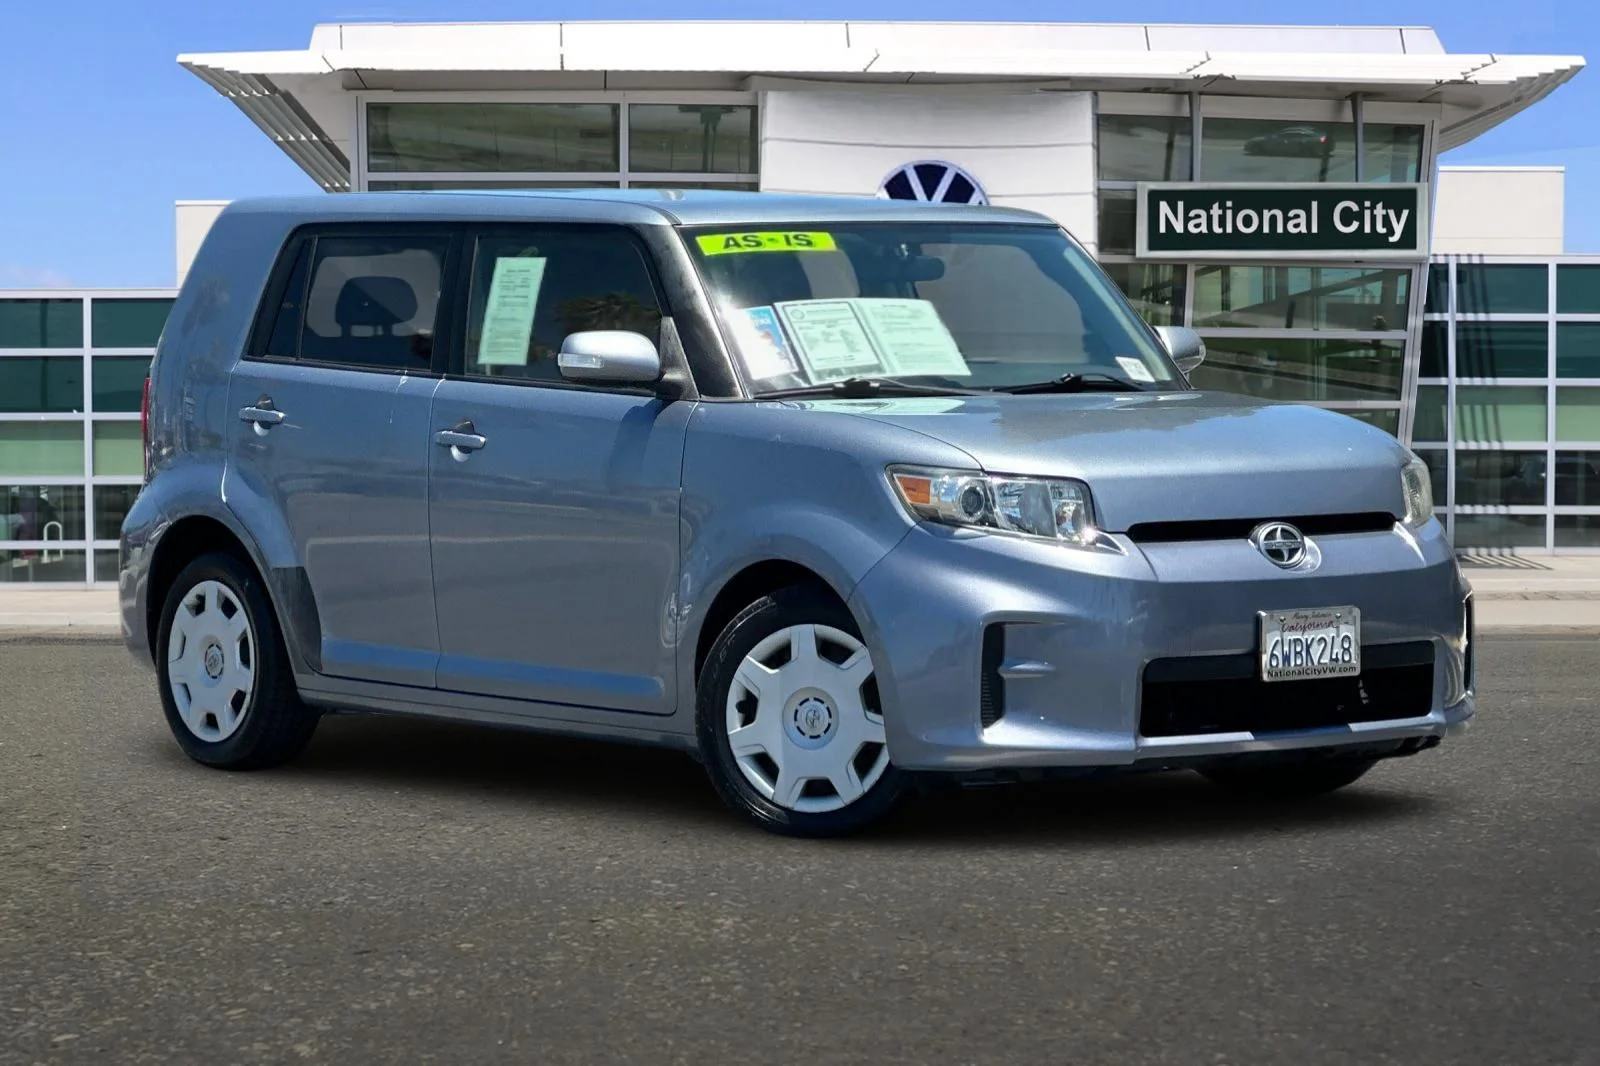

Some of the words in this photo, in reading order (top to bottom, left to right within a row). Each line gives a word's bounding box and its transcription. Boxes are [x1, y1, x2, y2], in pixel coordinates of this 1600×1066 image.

[1159, 200, 1318, 234] National
[1332, 200, 1410, 243] City
[1281, 620, 1337, 634] California
[1269, 634, 1352, 668] 6WBK248
[1267, 666, 1357, 678] NationalCityVW.com
